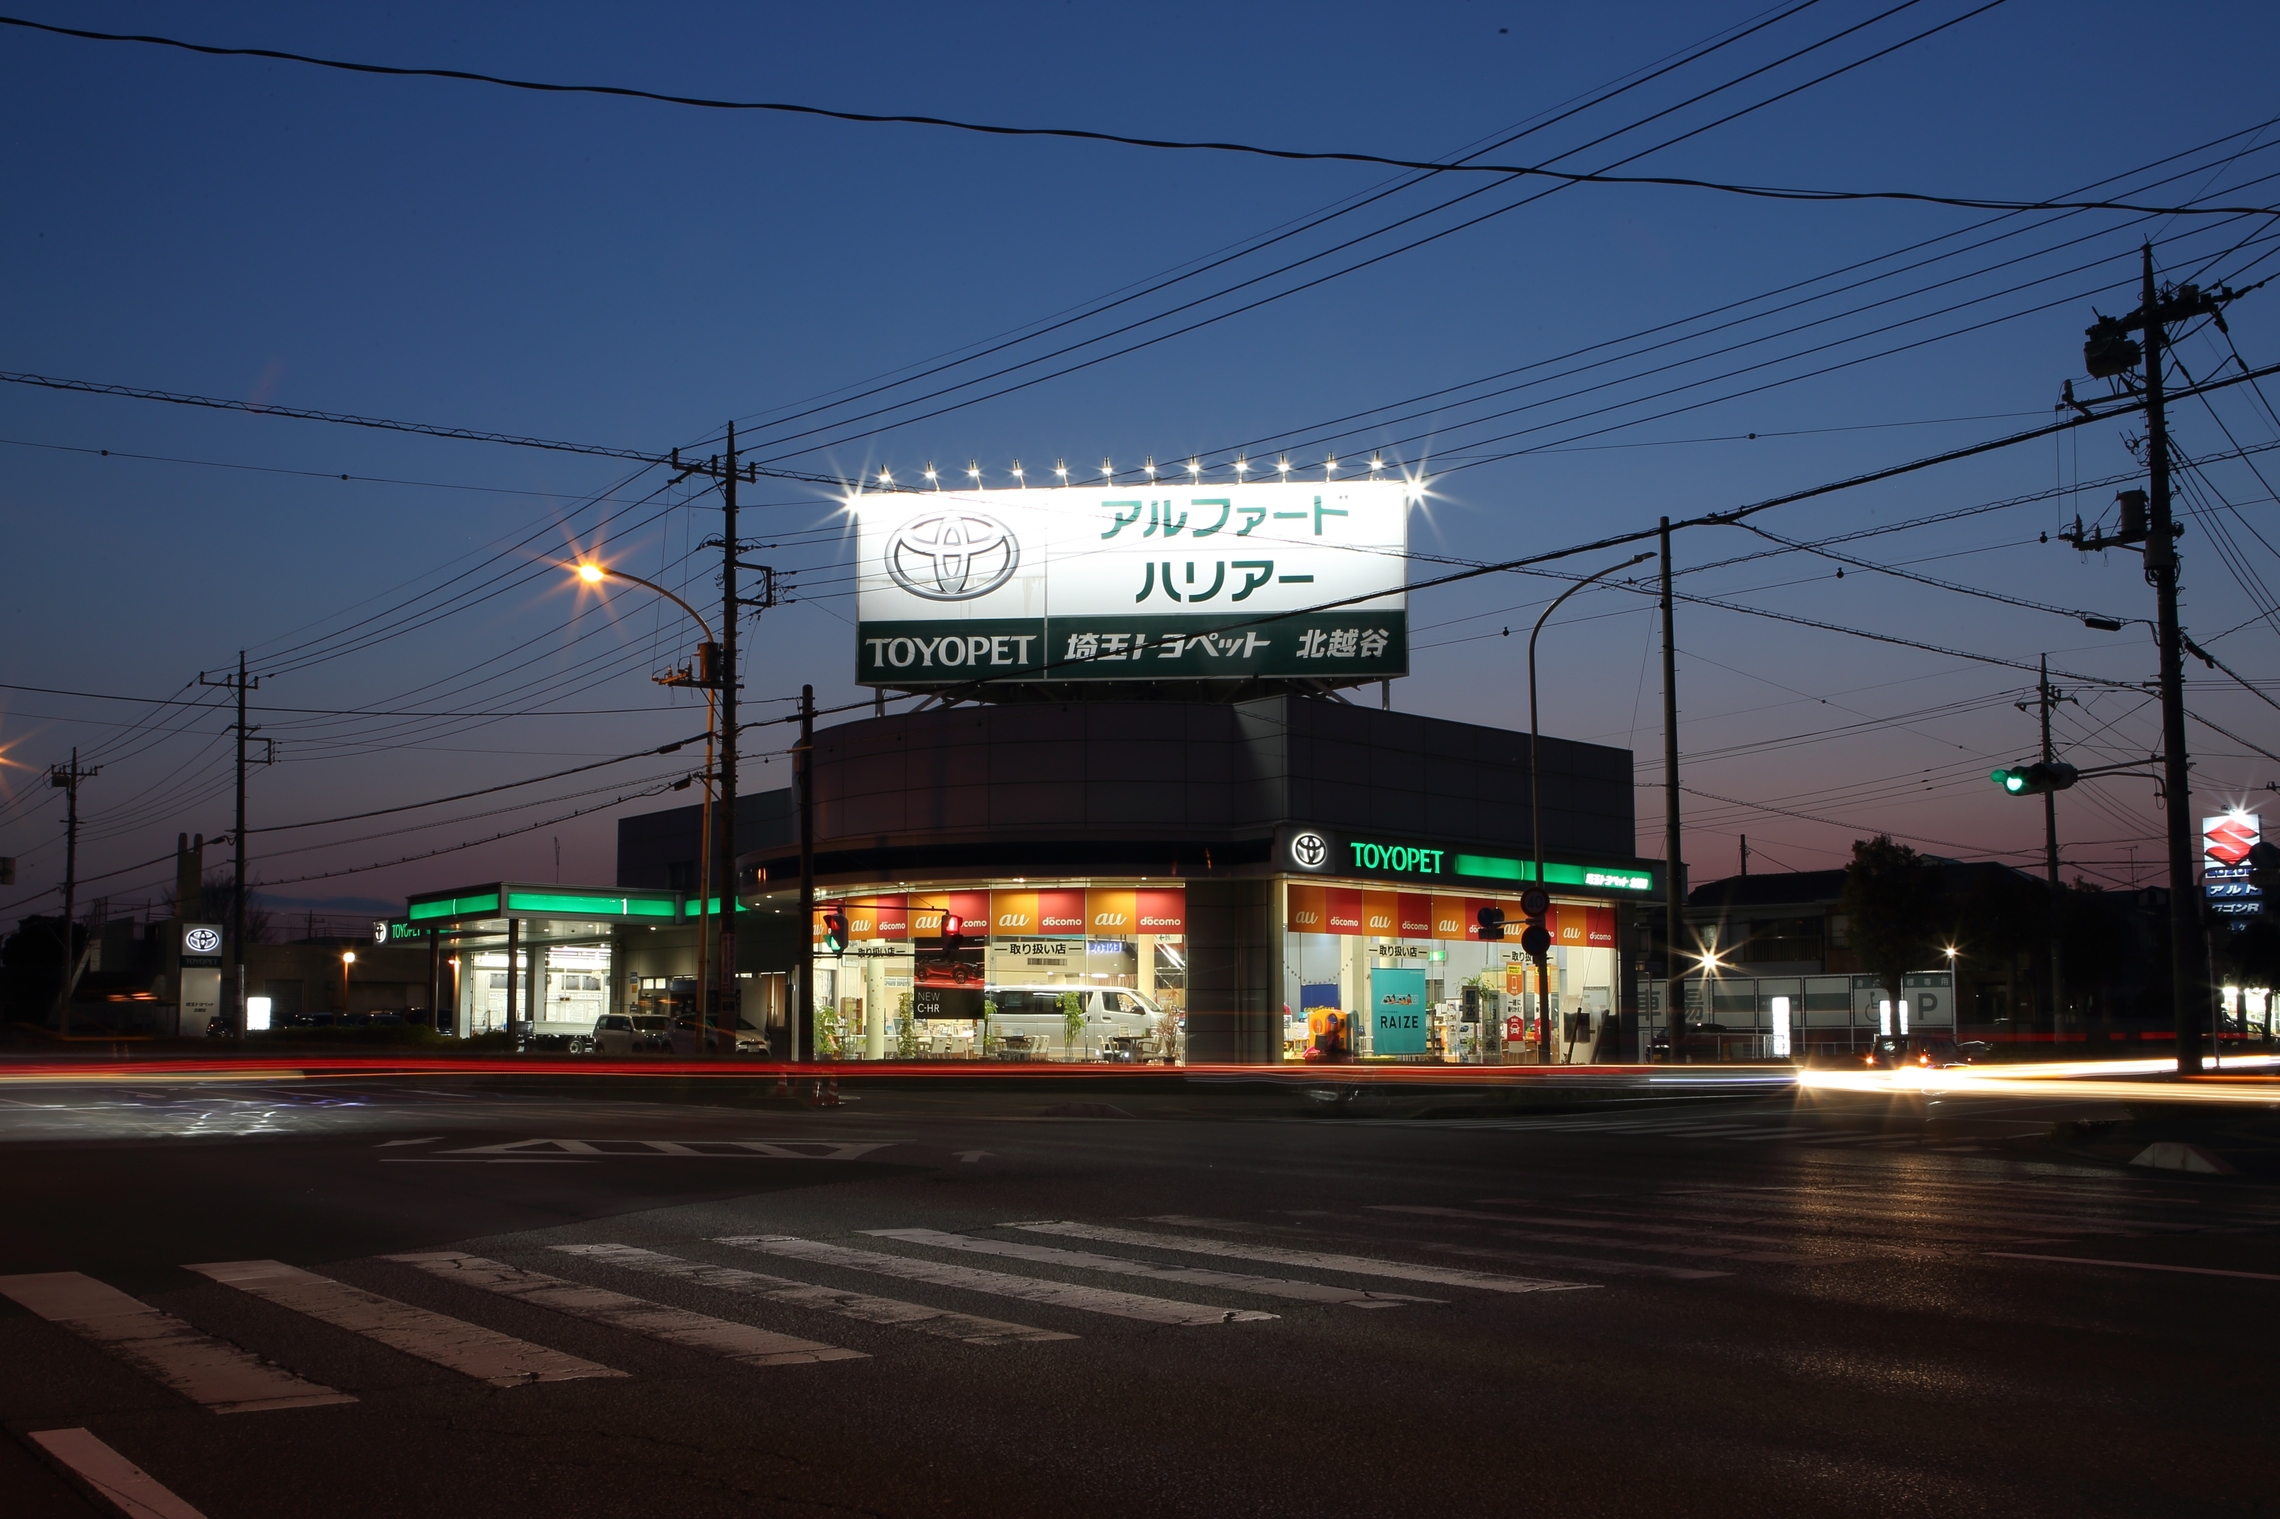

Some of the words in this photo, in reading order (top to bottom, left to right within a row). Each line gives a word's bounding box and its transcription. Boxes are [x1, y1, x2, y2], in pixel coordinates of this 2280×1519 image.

[1100, 495, 1349, 540] アルファード
[1135, 560, 1314, 603] ハリアー
[865, 634, 1037, 668] TOYOPET
[1064, 632, 1271, 662] 埼玉トヨペット
[1296, 628, 1390, 659] 北越谷
[1351, 842, 1444, 875] TOYOPET
[1527, 895, 1543, 909] 40
[915, 916, 942, 929] au
[961, 919, 987, 928] como
[999, 913, 1030, 927] au
[1042, 916, 1082, 926] docomo
[1094, 912, 1127, 926] au
[1140, 916, 1181, 926] docomo
[1295, 911, 1318, 924] au
[1330, 916, 1358, 927] docomo
[1369, 915, 1391, 928] au
[851, 919, 871, 932] au
[879, 921, 906, 931] docomo
[1402, 921, 1428, 931] docomo
[1438, 919, 1459, 932] au
[1504, 923, 1522, 936] au
[1563, 927, 1580, 939] au
[1589, 931, 1611, 941] docomo
[1009, 943, 1066, 955] 取り扱い店
[1379, 945, 1417, 957] 取り扱い店
[917, 992, 941, 1001] NEW
[1917, 993, 1938, 1020] P
[1381, 1016, 1419, 1029] RAIZE
